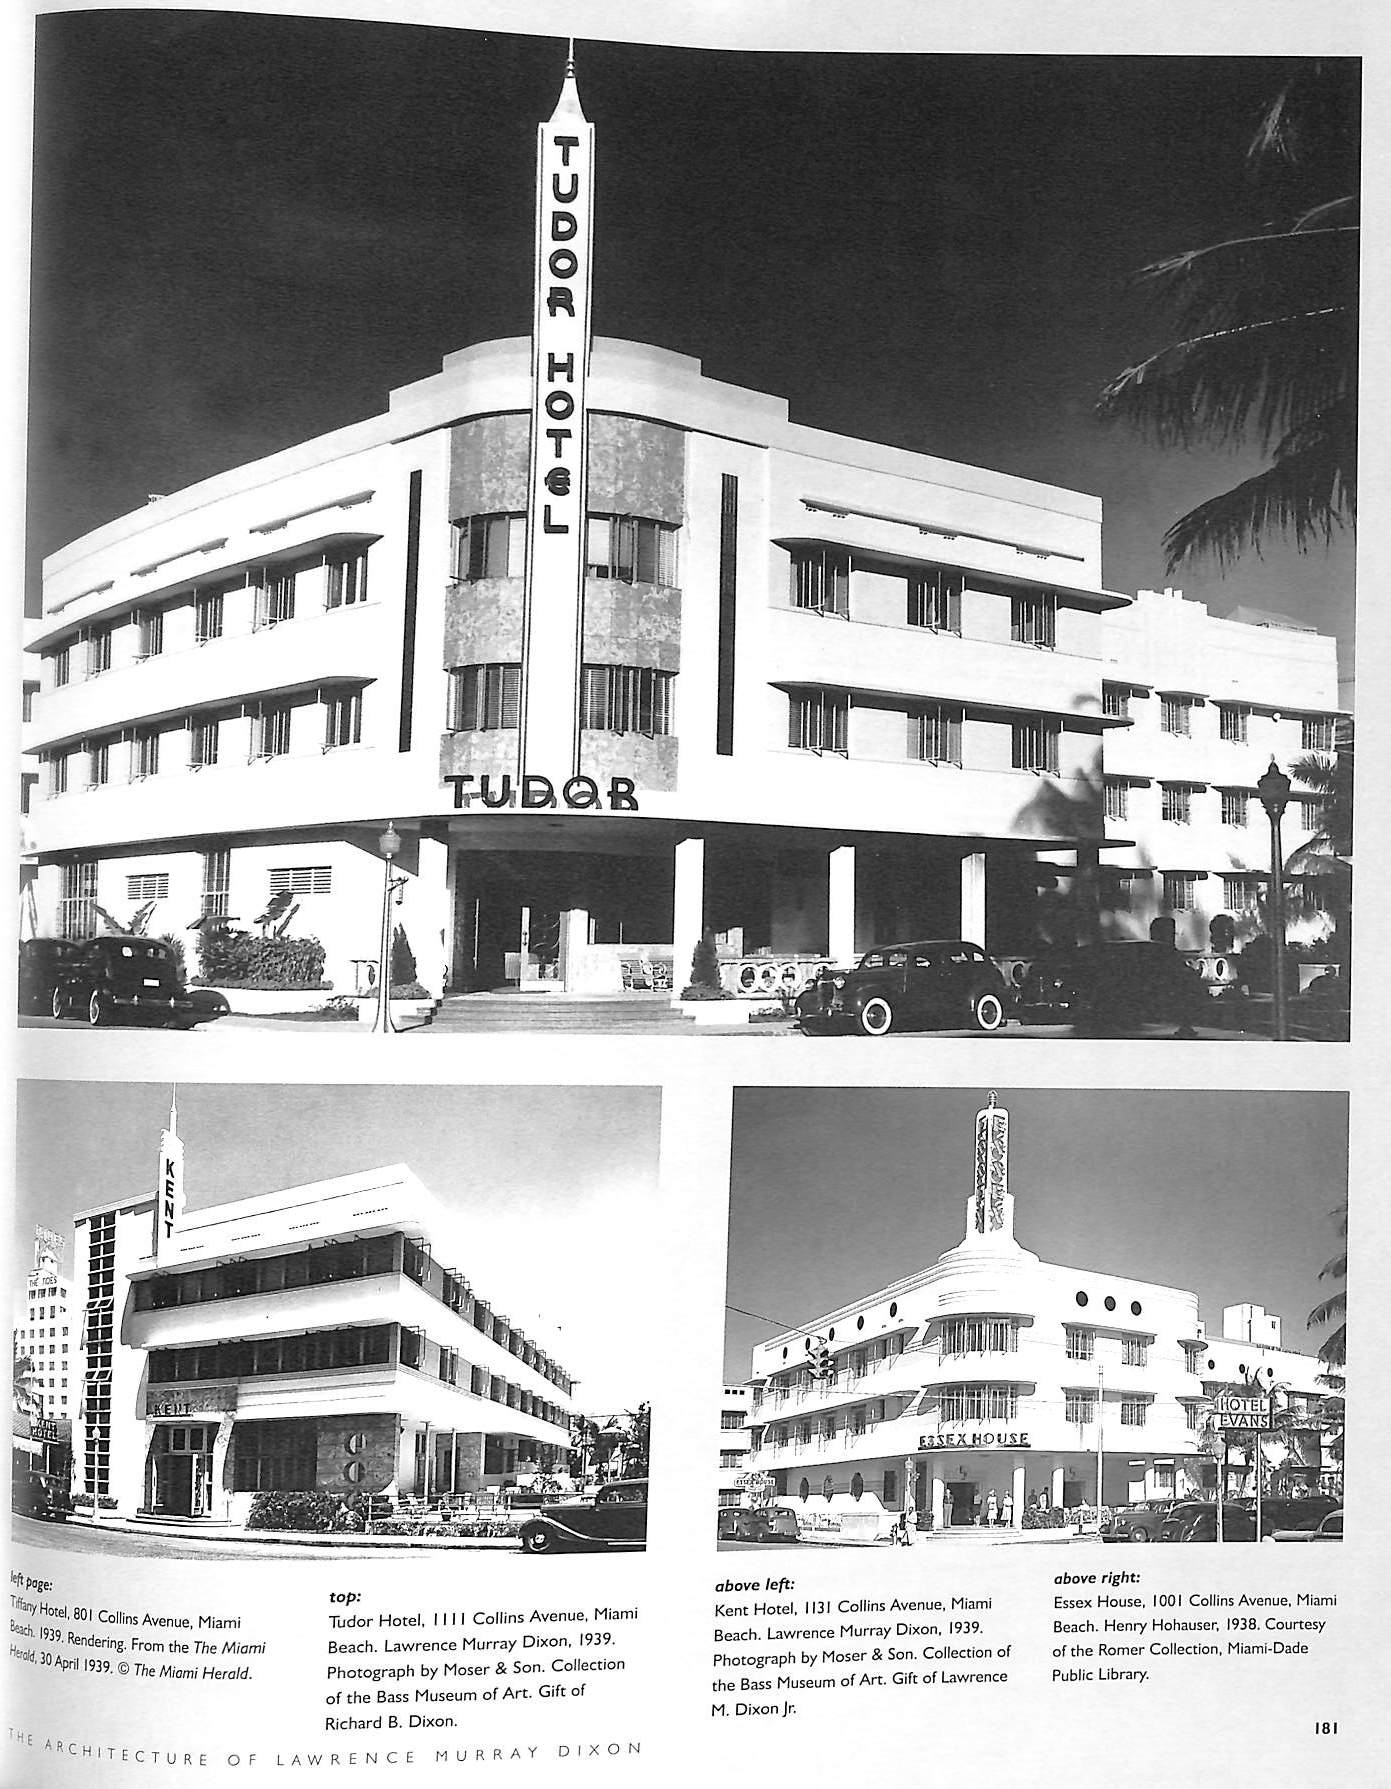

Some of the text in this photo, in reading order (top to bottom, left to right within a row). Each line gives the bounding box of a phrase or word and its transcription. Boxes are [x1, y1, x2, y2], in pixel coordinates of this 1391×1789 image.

[543, 136, 580, 535] TUDOR HOTEL
[444, 775, 639, 811] TUDOR
[164, 1158, 175, 1239] KENT
[154, 1403, 191, 1416] KENT
[1220, 1397, 1267, 1412] HOTEL
[1220, 1413, 1268, 1428] EVANS
[31, 1427, 57, 1440] HOTEL
[919, 1432, 1029, 1447] ESSEX HOUSE
[10, 1570, 53, 1593] left page:
[715, 1577, 795, 1593] above left:
[1054, 1571, 1140, 1587] above right:
[330, 1592, 361, 1606] top:
[715, 1597, 991, 1618] Kent Hotel, 1131 Collins Avenue, Miami
[1055, 1594, 1336, 1610] Essex House, 1001 Collins Avenue, Miami
[10, 1595, 241, 1630] Tiffany Hotel, 801 Collins Avenue, Miami
[329, 1607, 637, 1630] Tudor Hotel, 1111 Collins Avenue, Miami
[10, 1619, 266, 1654] Beach. 1939. Rendering. From the The Miami
[714, 1621, 983, 1642] Beach. Lawrence Murray Dixon, 1939.
[1054, 1618, 1326, 1635] Beach. Henry Hohauser, 1938. Courtesy
[329, 1632, 615, 1654] Beach. Lawrence Murray Dixon, 1939.
[1053, 1642, 1308, 1657] of the Romer Collection, Miami-Dade
[10, 1644, 37, 1664] Herald,
[40, 1652, 52, 1666] 30
[55, 1655, 79, 1672] April
[84, 1659, 113, 1674] 1939.
[134, 1663, 156, 1677] The
[159, 1665, 198, 1679] Miami
[203, 1667, 252, 1680] Herald.
[714, 1645, 1011, 1669] Photograph by Moser & Son. Collection of
[328, 1659, 625, 1681] Photograph by Moser & Son. Collection
[1053, 1667, 1149, 1683] Public Library.
[713, 1671, 1007, 1692] the Bass Museum of Art. Gift of Lawrence
[326, 1684, 586, 1705] of the Bass Museum of Art. Gift of
[712, 1701, 797, 1717] M. Dixon Jr.
[326, 1715, 457, 1730] Richard B. Dixon.
[1315, 1721, 1338, 1735] 181
[8, 1727, 641, 1767] THE ARCHITECTURE OF LAWRENCE MURRAY DIXON
